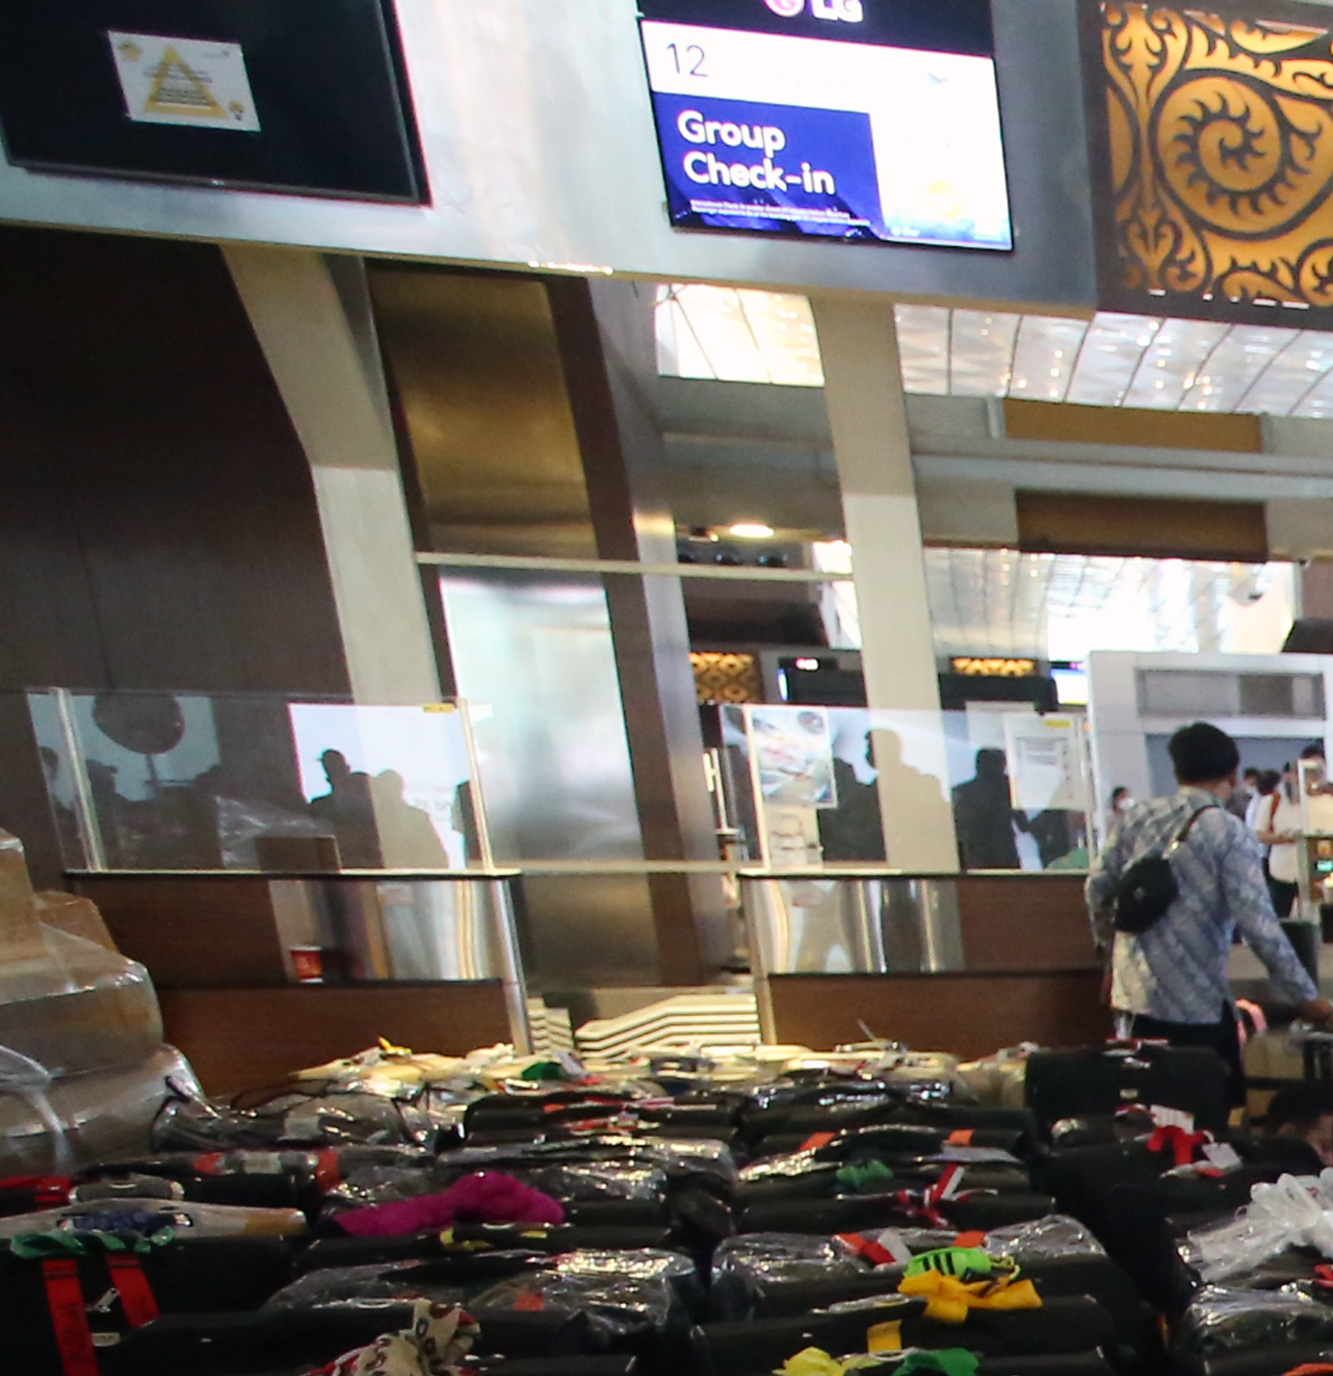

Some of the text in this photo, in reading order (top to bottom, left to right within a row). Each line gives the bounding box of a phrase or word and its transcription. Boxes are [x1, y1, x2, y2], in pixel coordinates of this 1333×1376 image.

[667, 43, 709, 77] 12
[676, 109, 786, 157] Group
[683, 151, 836, 195] Check-in
